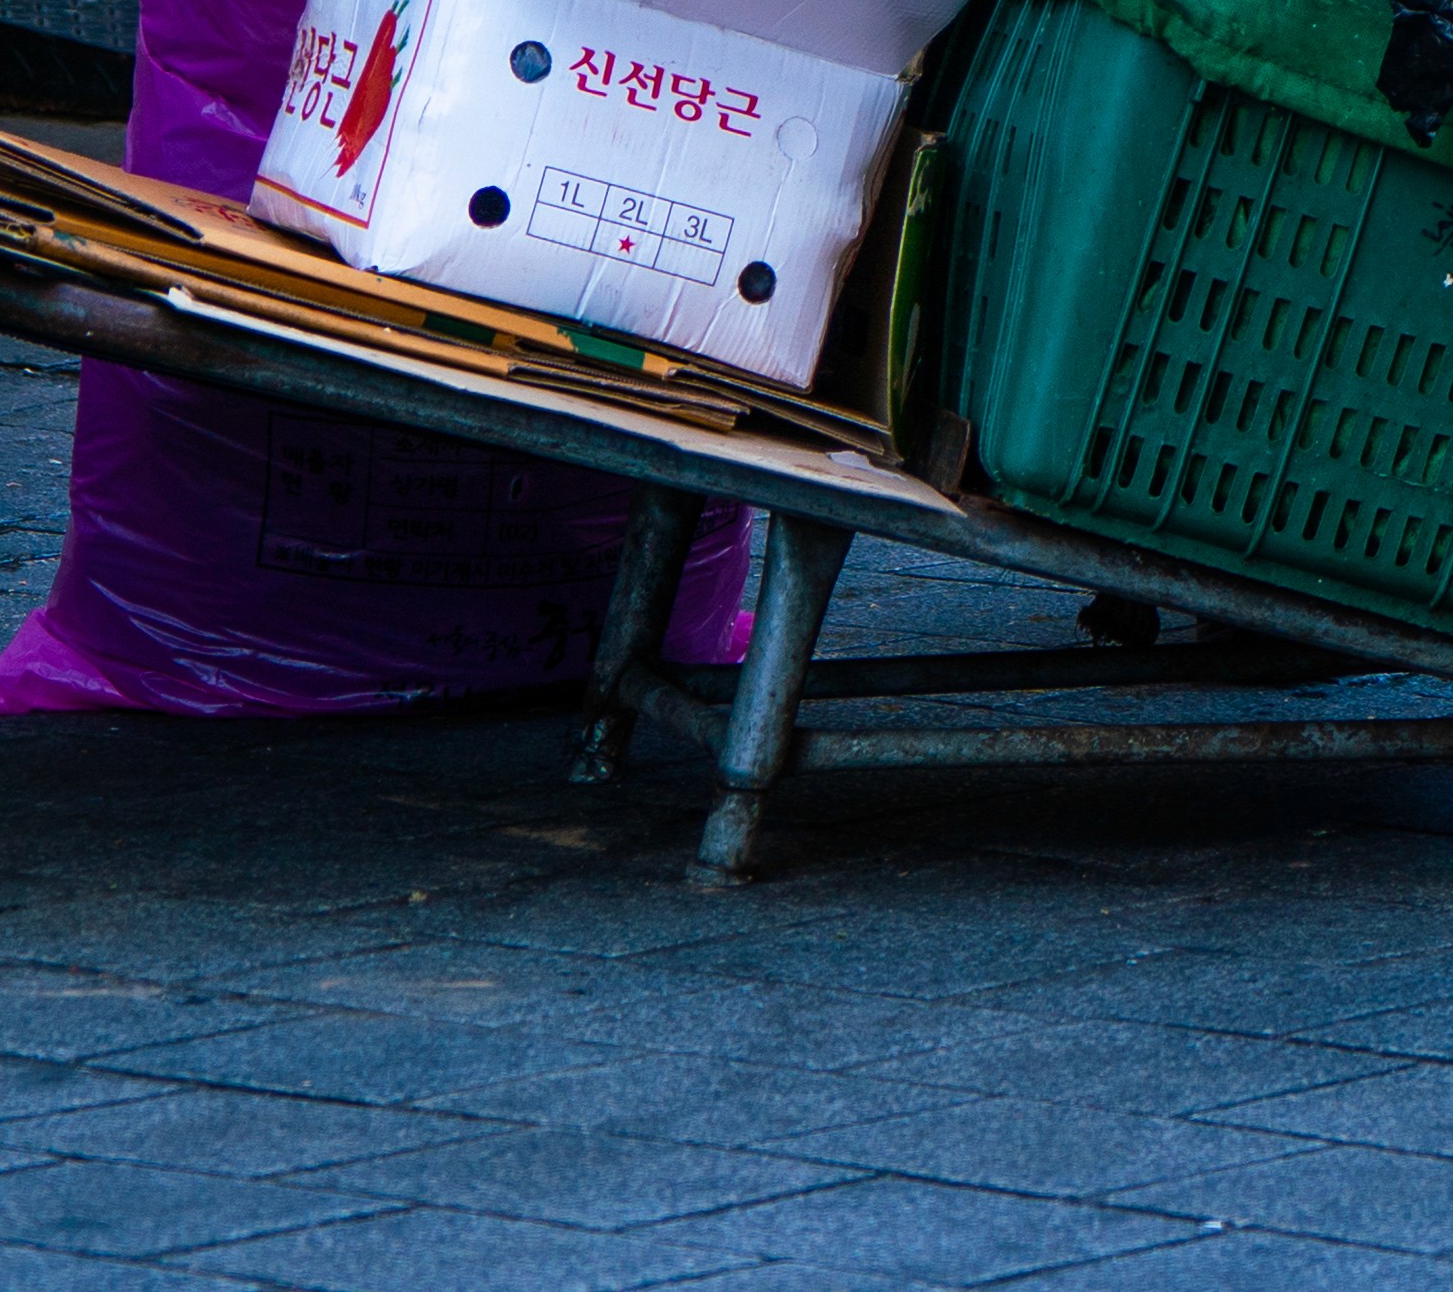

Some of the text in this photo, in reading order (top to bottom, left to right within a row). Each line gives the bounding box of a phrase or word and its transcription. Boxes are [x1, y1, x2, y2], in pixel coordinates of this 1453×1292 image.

[568, 45, 763, 139] 신선당근
[559, 180, 585, 209] 1L
[618, 196, 648, 227] 2L
[683, 216, 713, 244] 3L
